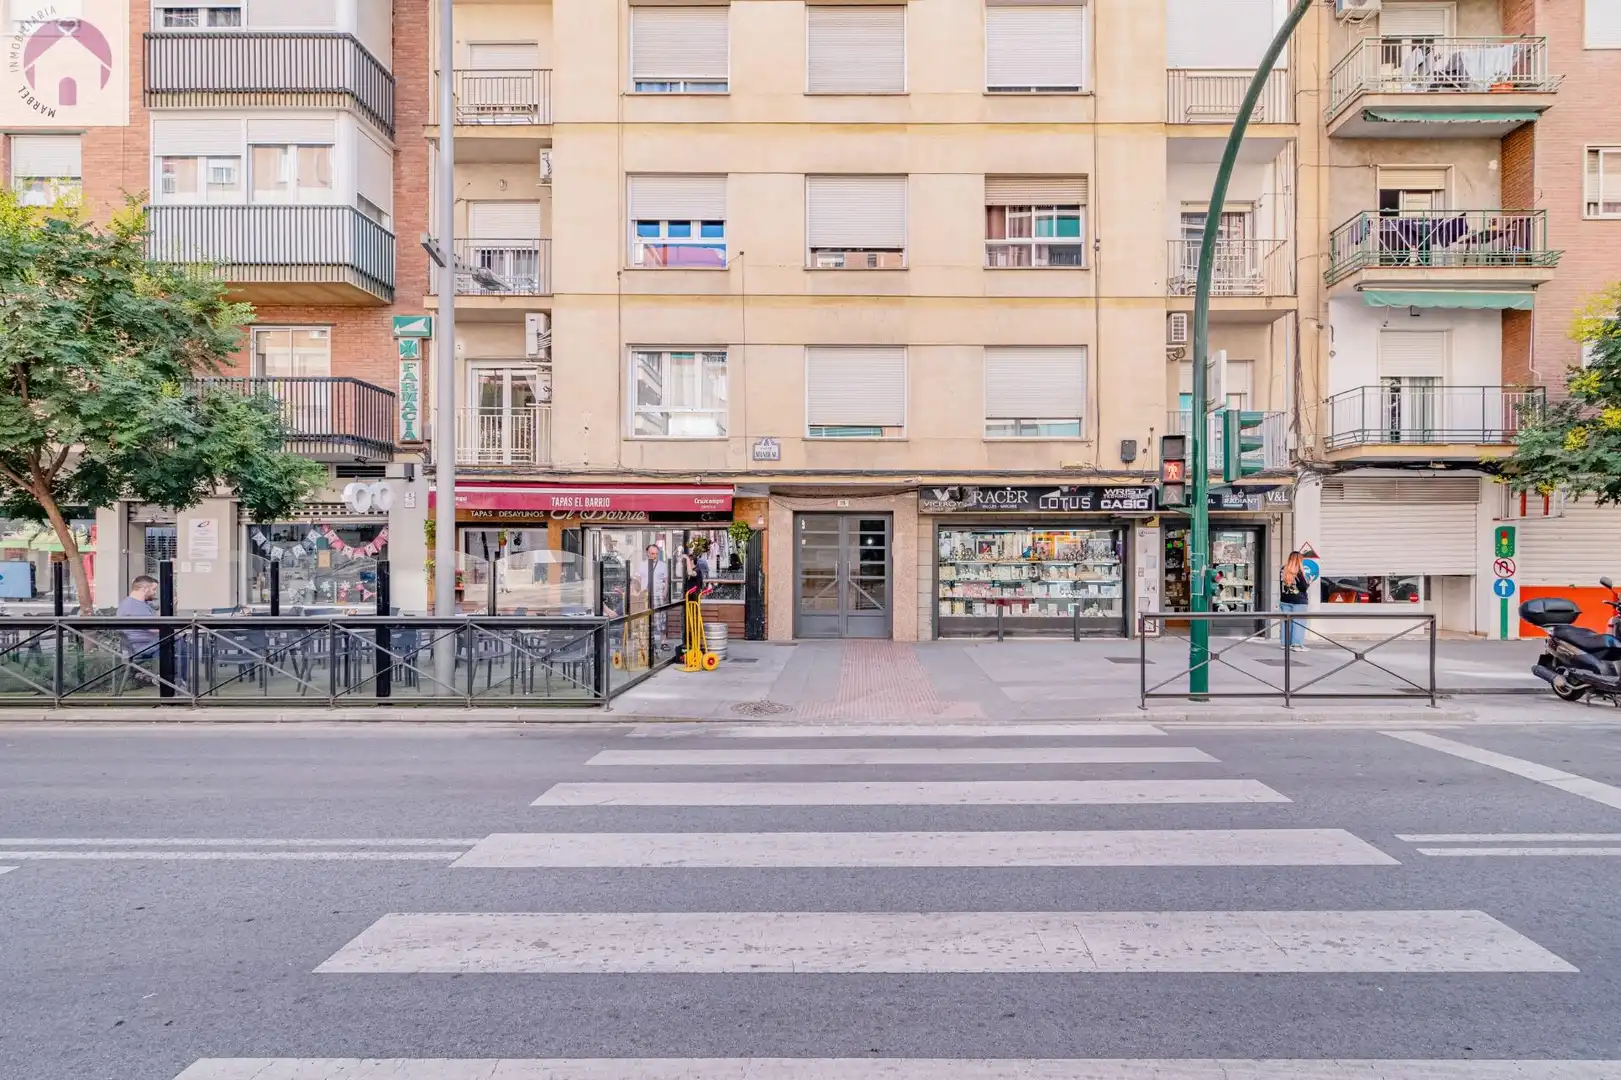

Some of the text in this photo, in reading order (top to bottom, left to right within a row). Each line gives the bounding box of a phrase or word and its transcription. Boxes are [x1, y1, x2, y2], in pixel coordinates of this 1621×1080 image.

[400, 362, 418, 441] FARMACIA
[551, 497, 611, 508] TAPAS EL BARRIO
[972, 490, 1029, 504] RACER
[1039, 496, 1091, 509] LOTUS
[1266, 491, 1289, 502] V&L
[1100, 499, 1149, 509] CASIO
